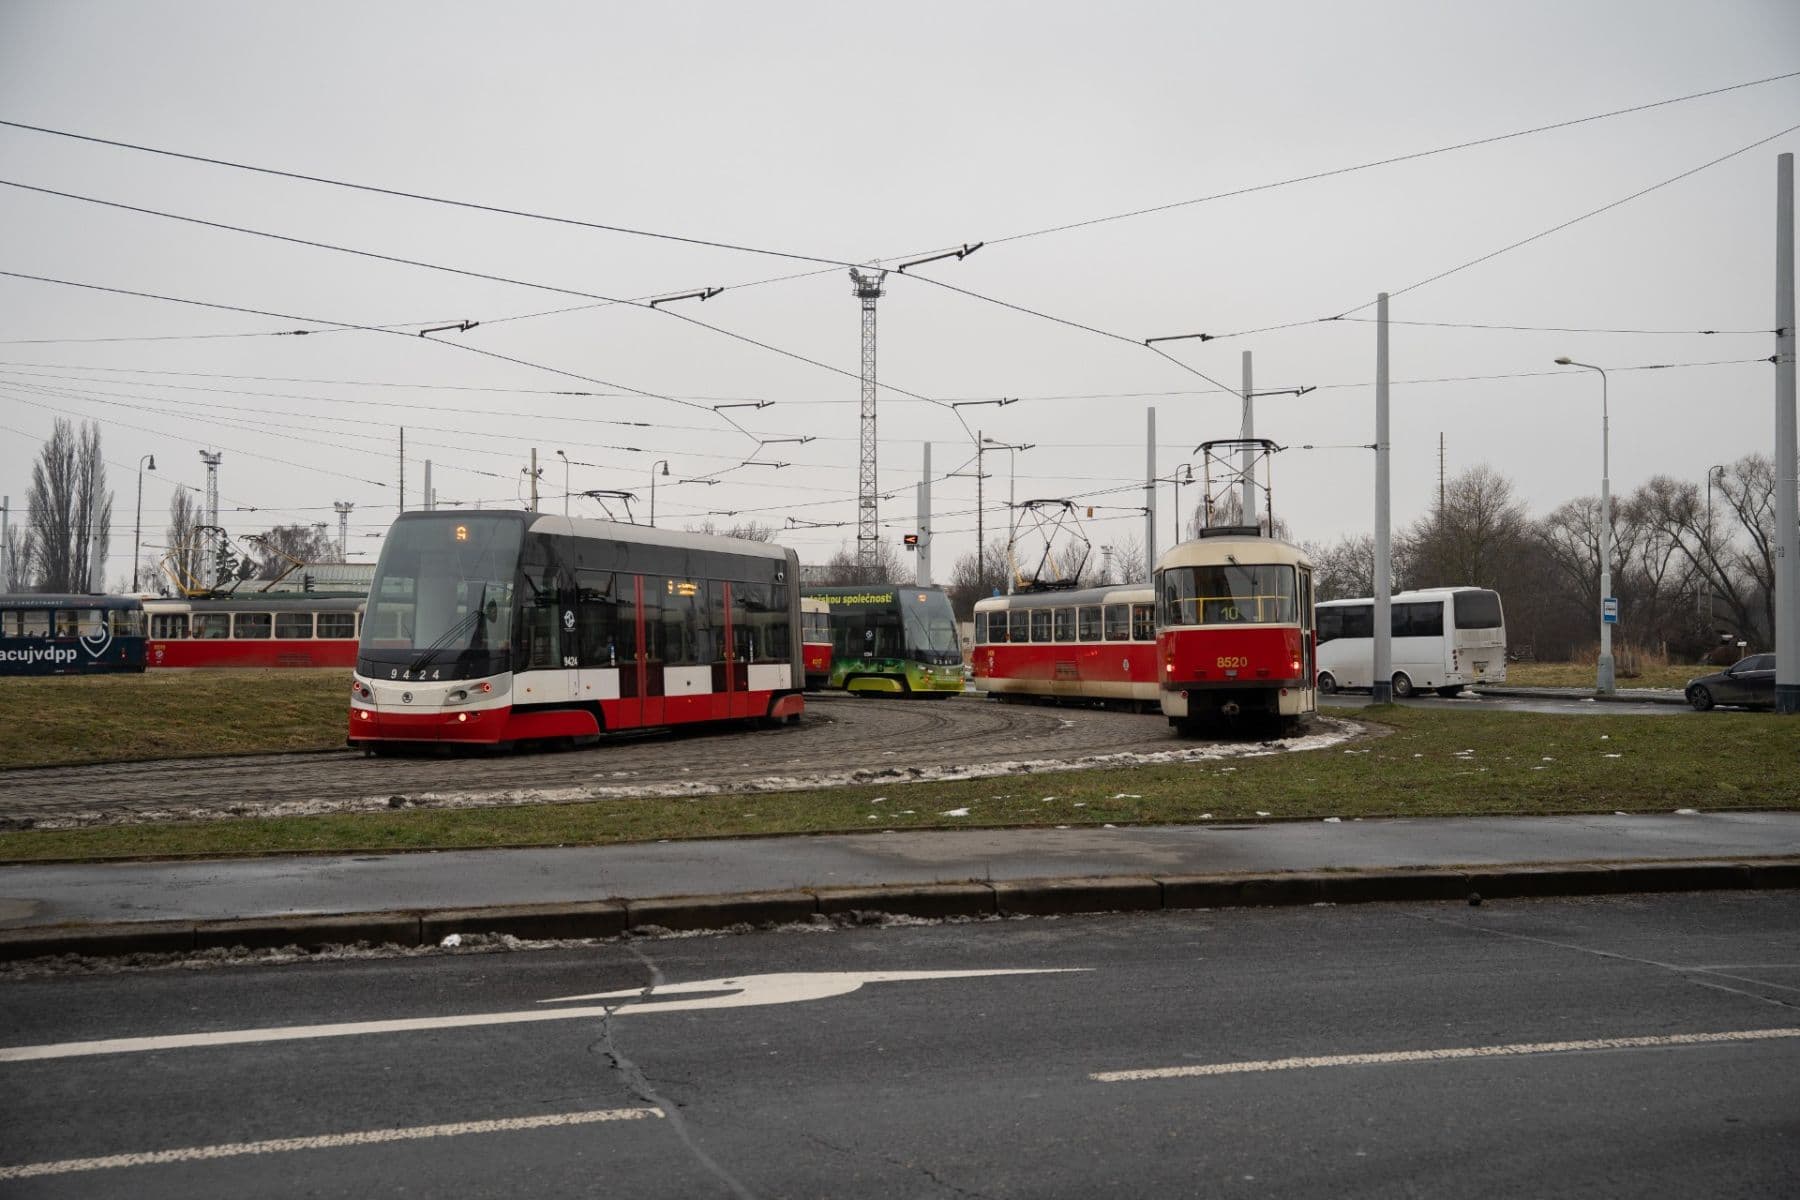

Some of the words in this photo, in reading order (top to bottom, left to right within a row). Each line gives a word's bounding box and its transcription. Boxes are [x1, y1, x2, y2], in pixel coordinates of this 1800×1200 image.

[1221, 606, 1239, 620] 10
[563, 656, 578, 667] 9424
[1217, 656, 1248, 669] 8520
[390, 668, 440, 681] 9424
